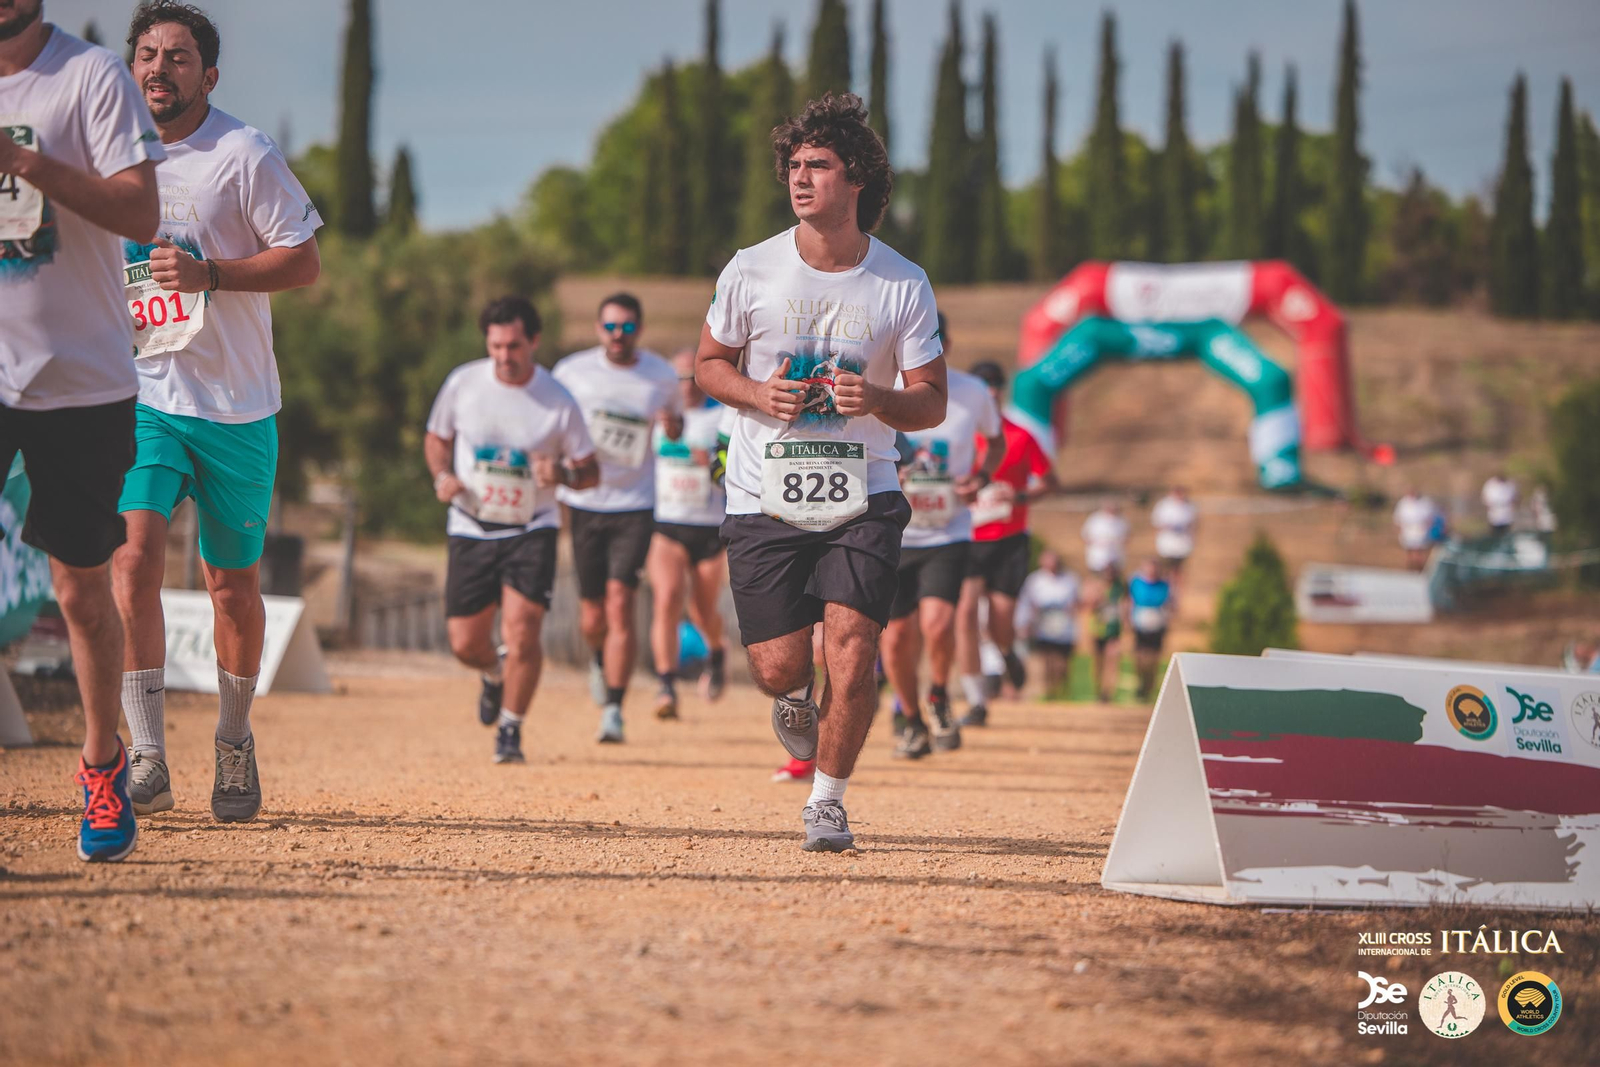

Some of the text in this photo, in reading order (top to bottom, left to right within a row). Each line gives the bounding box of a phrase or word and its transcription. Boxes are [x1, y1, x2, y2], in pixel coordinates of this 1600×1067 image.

[160, 201, 200, 222] ICA
[132, 291, 190, 332] 301
[829, 302, 866, 314] CROSS
[783, 314, 874, 342] ITÁLICA
[791, 443, 839, 455] ITÁLICA
[482, 483, 523, 508] 252
[783, 472, 849, 503] 828
[1513, 725, 1560, 739] Diputación
[1516, 736, 1563, 754] Sevilla
